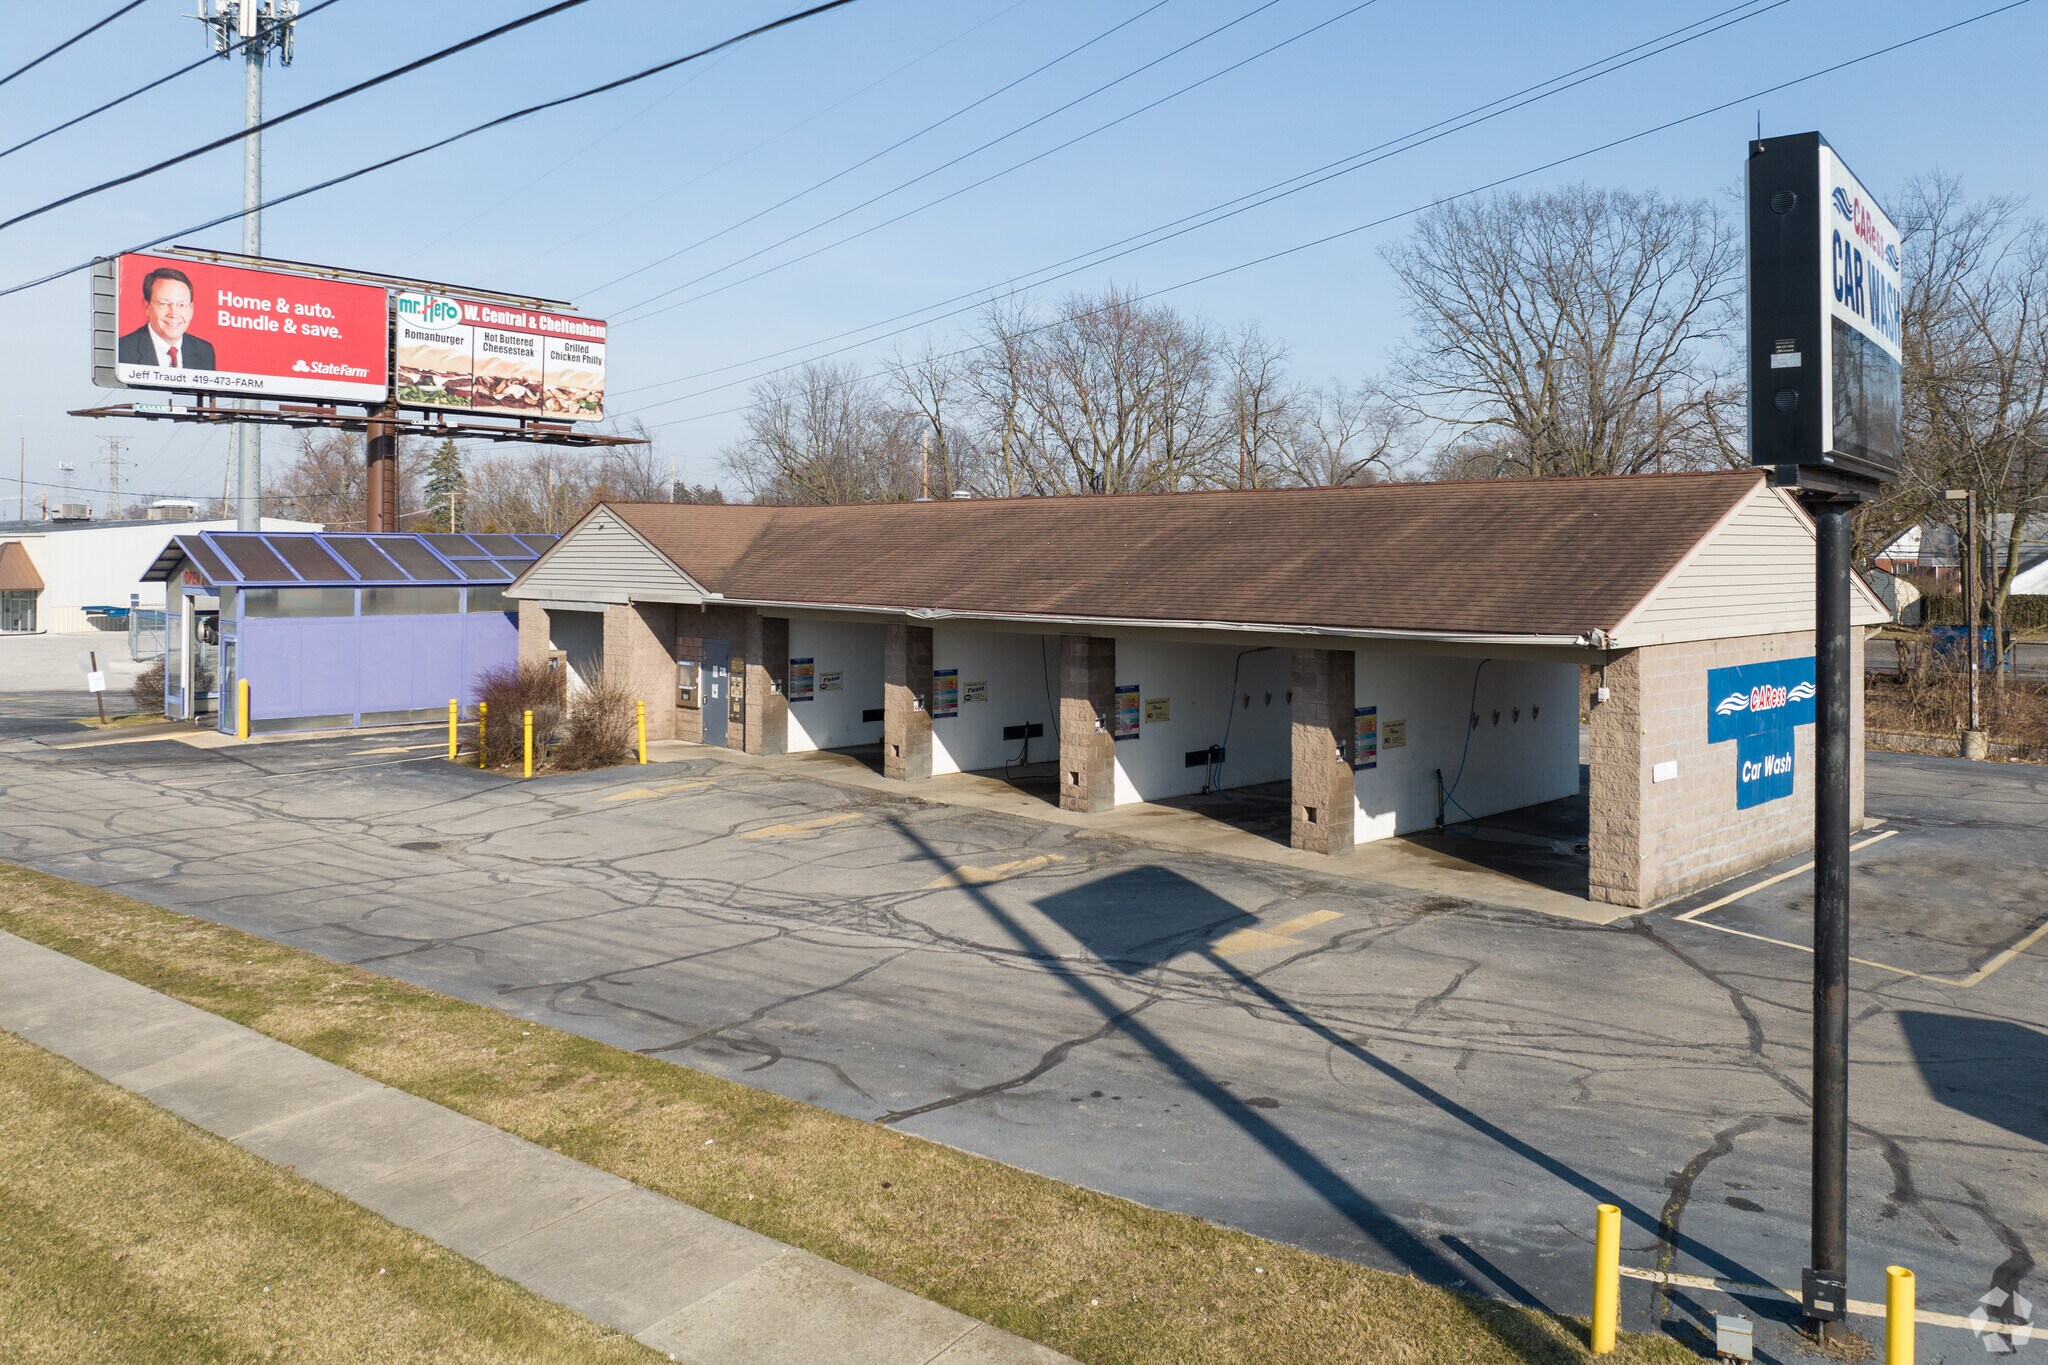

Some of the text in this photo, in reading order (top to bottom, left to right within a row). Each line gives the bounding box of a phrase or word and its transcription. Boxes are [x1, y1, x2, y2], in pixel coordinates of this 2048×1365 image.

[1854, 197, 1885, 261] CARess
[1832, 229, 1901, 351] CAR WASH
[218, 290, 335, 319] Home & auto.
[218, 310, 342, 339] Bundle & save.
[464, 304, 606, 339] W. Central & Cheltenham
[405, 329, 464, 345] Romanburger
[485, 332, 534, 348] Hot Buttered
[564, 342, 589, 354] Grilled
[483, 342, 535, 357] Cheesesteak
[550, 350, 602, 366] Chicken Philly
[128, 370, 264, 389] Jeff Traudt 419-473-FARM
[967, 685, 985, 694] Please
[1750, 684, 1787, 712] CARess
[1742, 752, 1792, 783] Car Wash
